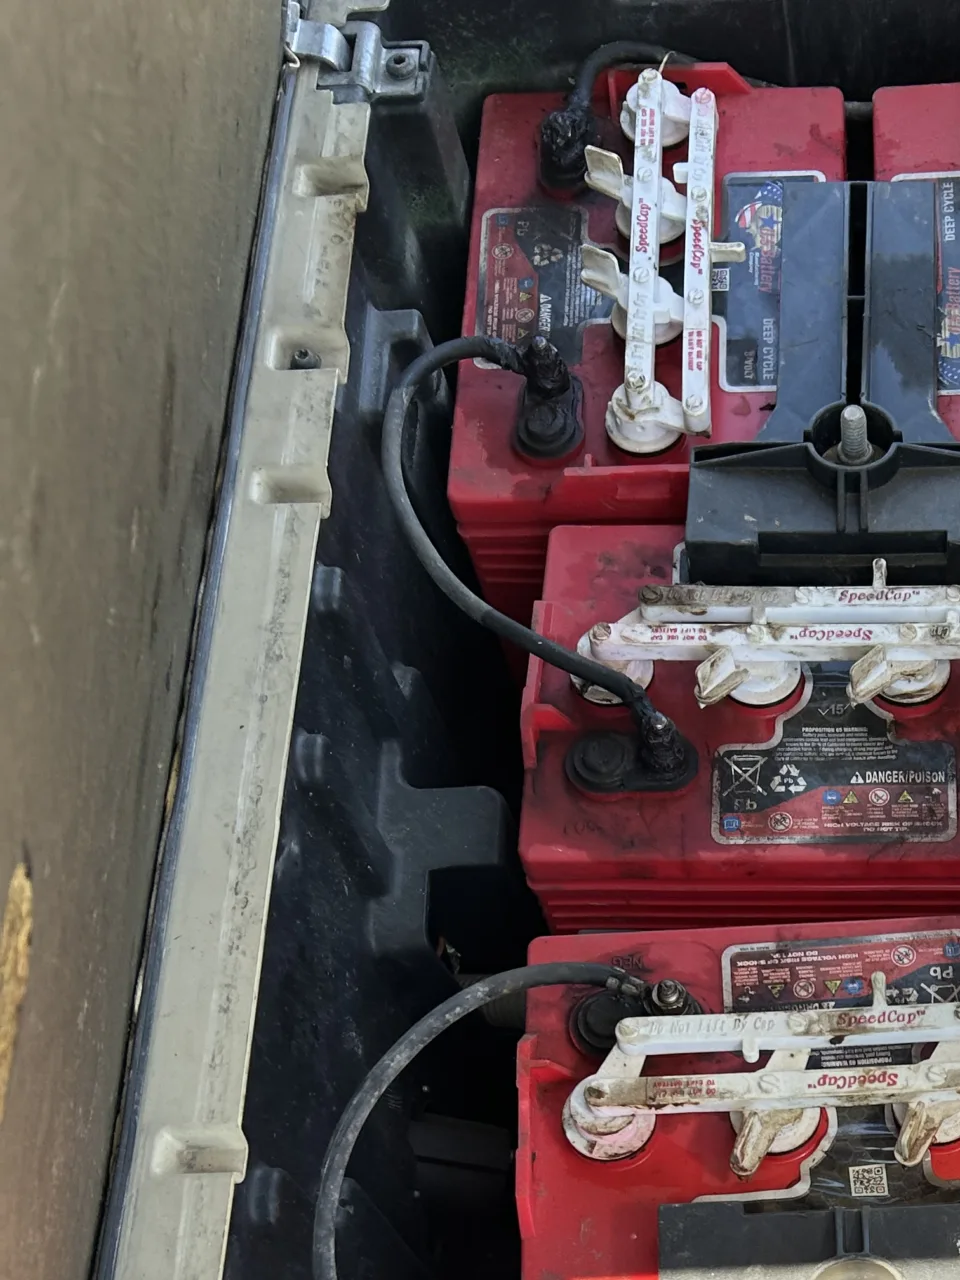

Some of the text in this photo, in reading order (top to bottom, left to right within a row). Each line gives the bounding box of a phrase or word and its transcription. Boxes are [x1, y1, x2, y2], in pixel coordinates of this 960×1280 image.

[943, 182, 956, 241] DEEP CYCLE
[759, 250, 776, 293] Battery
[762, 318, 774, 380] DEEP CYCLE
[801, 955, 837, 963] VOLTAGE
[930, 966, 954, 979] Pb
